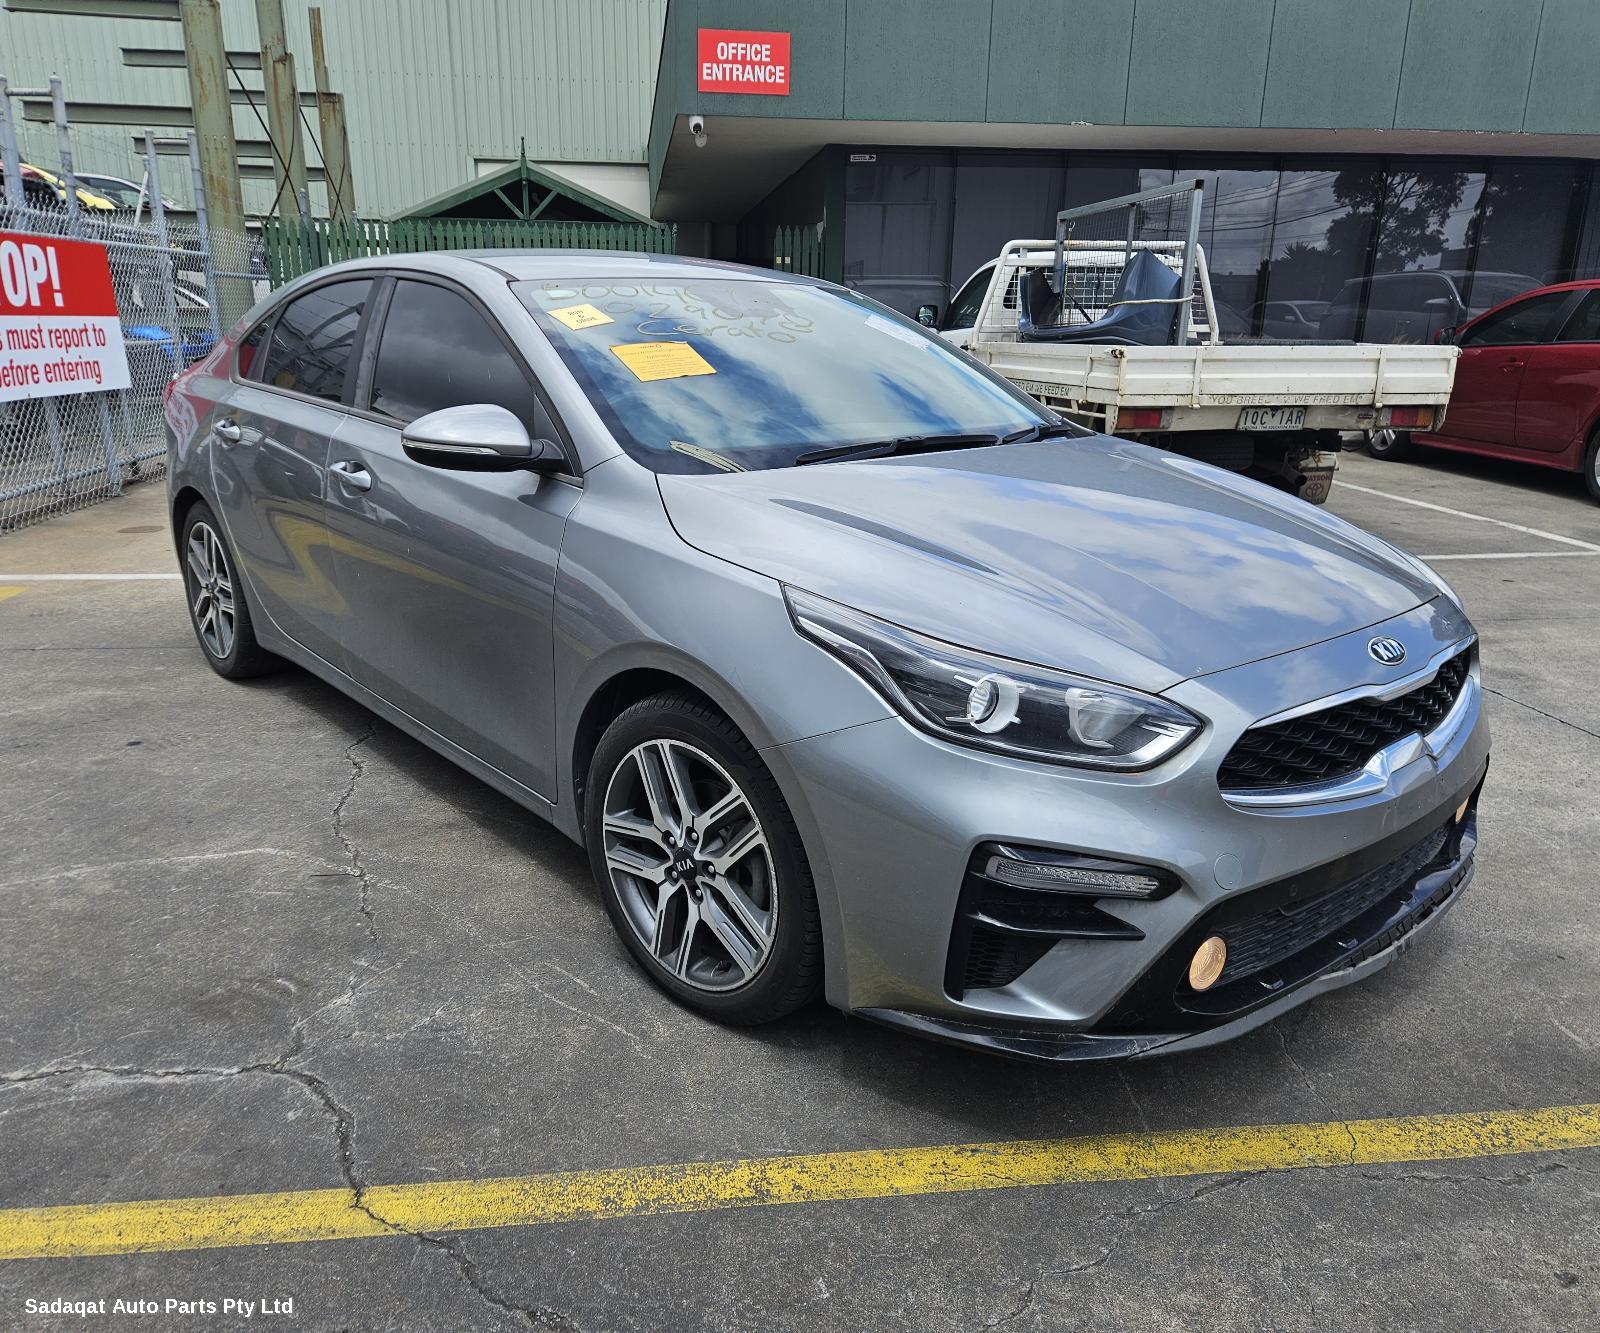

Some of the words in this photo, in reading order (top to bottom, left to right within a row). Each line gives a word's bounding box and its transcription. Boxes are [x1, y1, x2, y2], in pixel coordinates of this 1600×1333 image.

[717, 42, 771, 62] OFFICE
[703, 63, 785, 83] ENTRANCE
[6, 323, 46, 349] must
[48, 322, 92, 352] report
[92, 325, 106, 347] to
[637, 320, 797, 344] Cerato
[0, 358, 40, 388] efore
[44, 355, 103, 385] entering
[1044, 385, 1060, 396] FEED
[1279, 410, 1304, 425] 1AR
[1371, 639, 1405, 661] KIA
[676, 858, 695, 872] KIA
